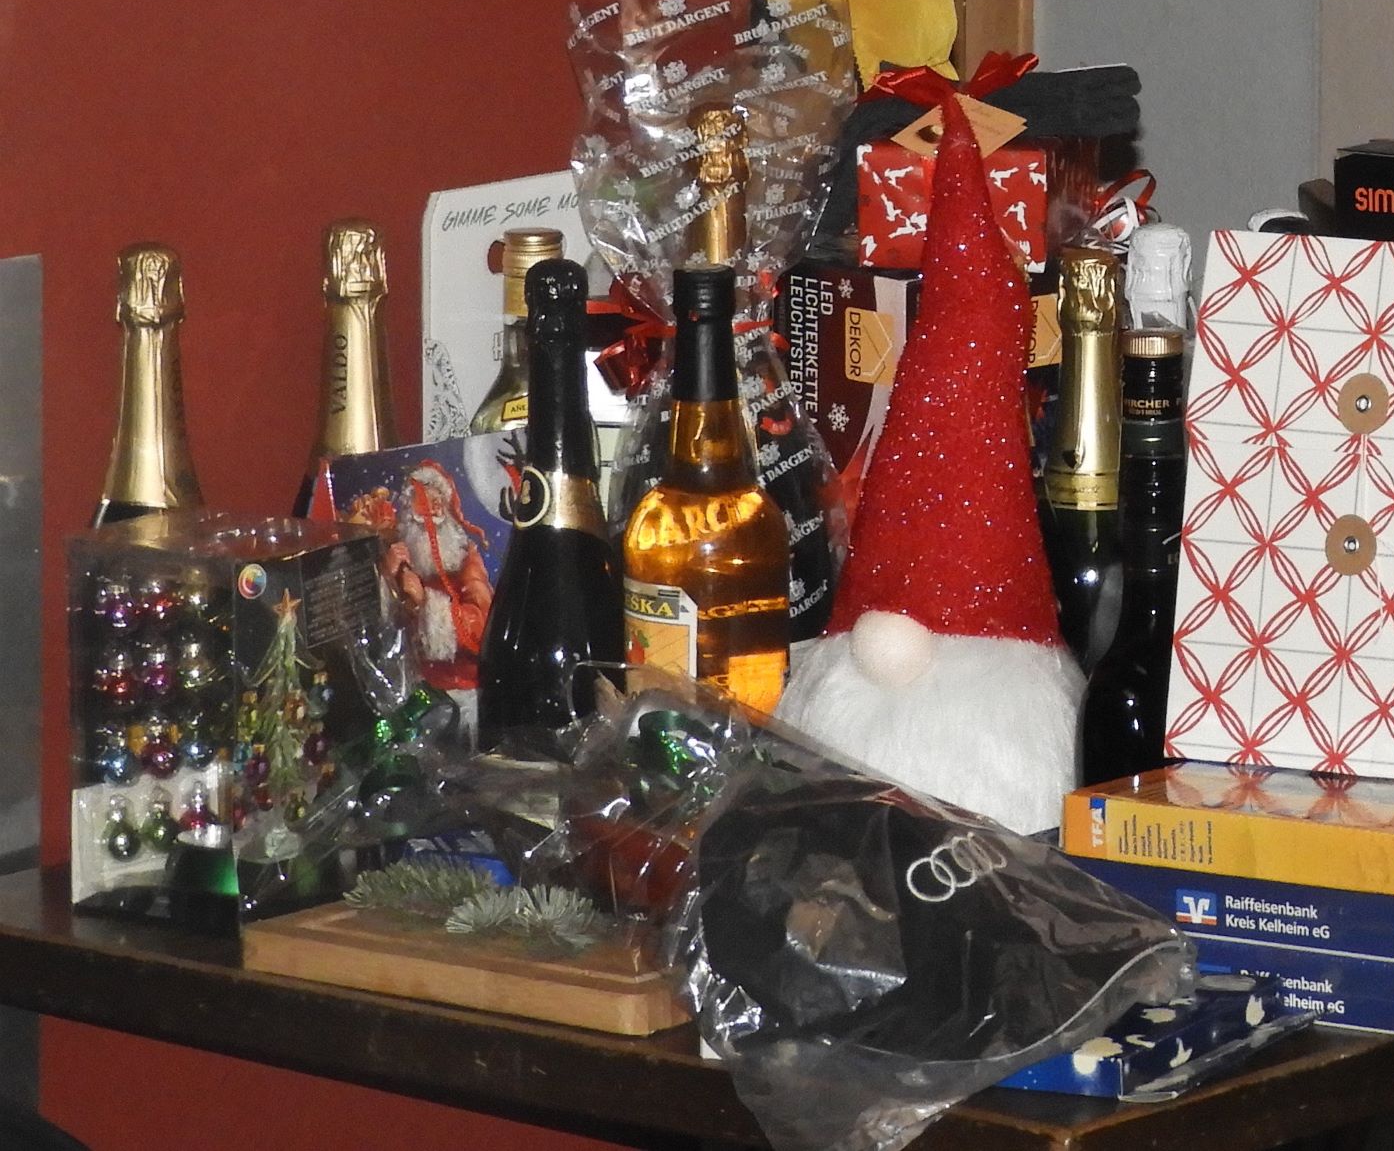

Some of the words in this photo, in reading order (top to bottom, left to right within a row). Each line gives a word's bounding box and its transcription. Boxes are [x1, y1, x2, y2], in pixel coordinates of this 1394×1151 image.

[624, 24, 665, 47] BRUT
[665, 1, 731, 32] DARGENT
[770, 3, 829, 33] DARGENT
[639, 154, 678, 179] BRUT
[441, 204, 498, 232] GIMME
[500, 196, 550, 225] SOME
[557, 191, 579, 211] MO
[646, 217, 683, 244] BRUT
[820, 280, 834, 316] LED
[805, 277, 819, 413] LICHTERKETTE
[849, 311, 862, 378] DEKOR
[328, 334, 348, 414] VALDO
[510, 403, 527, 414] AÑE
[766, 443, 814, 483] DARGEN
[789, 579, 828, 618] DARGEN
[1225, 895, 1318, 920] Raiffeisenbank
[1225, 914, 1256, 930] Kreis
[1259, 918, 1309, 937] Kelheim
[1312, 925, 1331, 939] eG
[1281, 992, 1324, 1012] elheim
